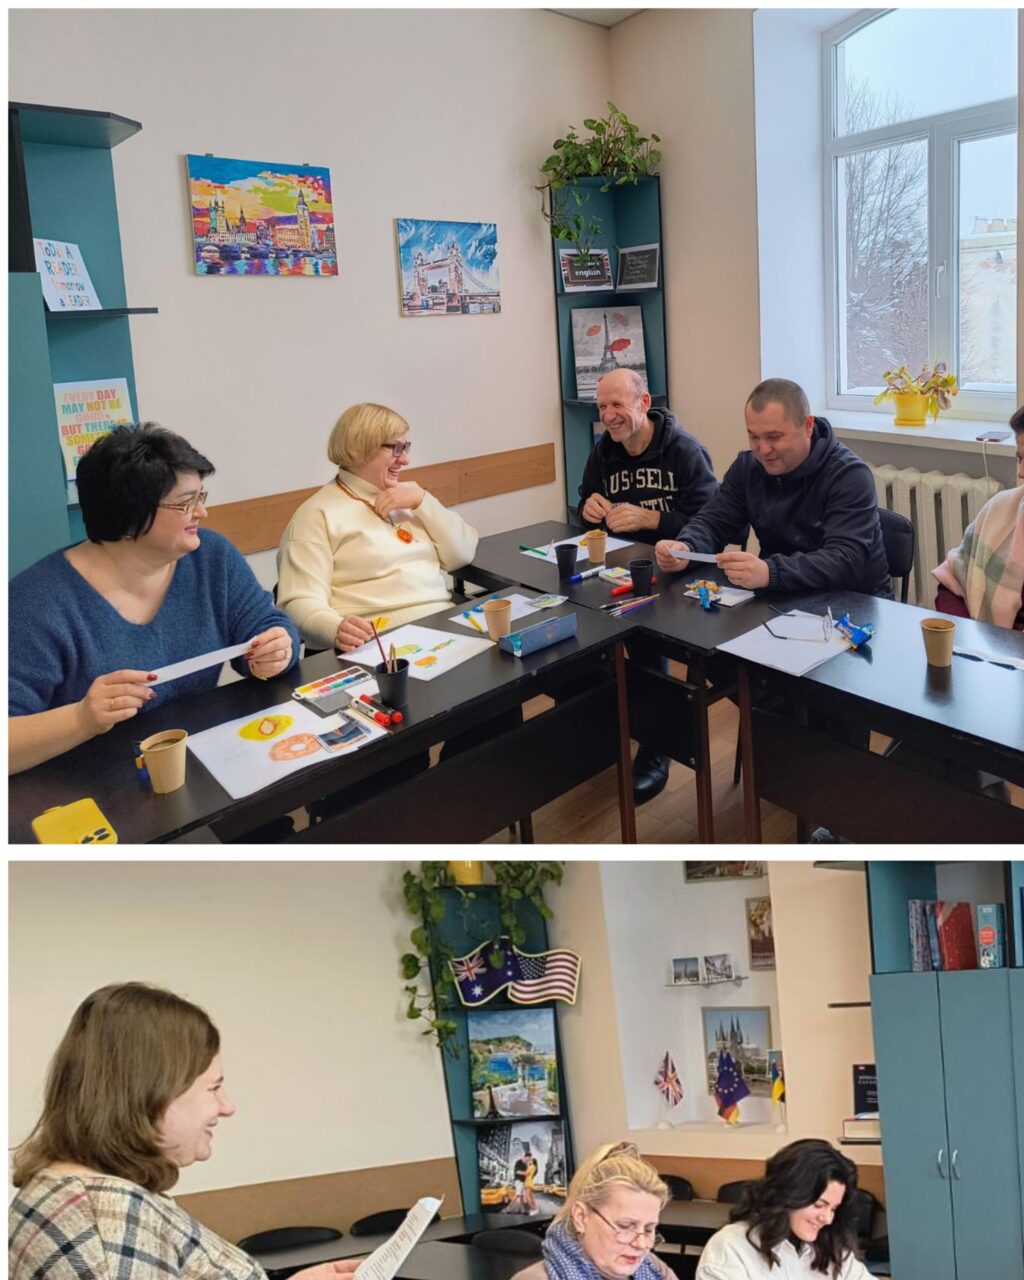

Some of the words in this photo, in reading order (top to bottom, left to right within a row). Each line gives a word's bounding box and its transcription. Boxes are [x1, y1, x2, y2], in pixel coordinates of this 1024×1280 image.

[44, 260, 81, 276] READER
[96, 389, 116, 400] DAY
[62, 402, 84, 414] MAY
[86, 400, 107, 412] NOT
[109, 399, 121, 409] BE
[61, 424, 82, 436] BUT
[603, 467, 678, 497] USSELL
